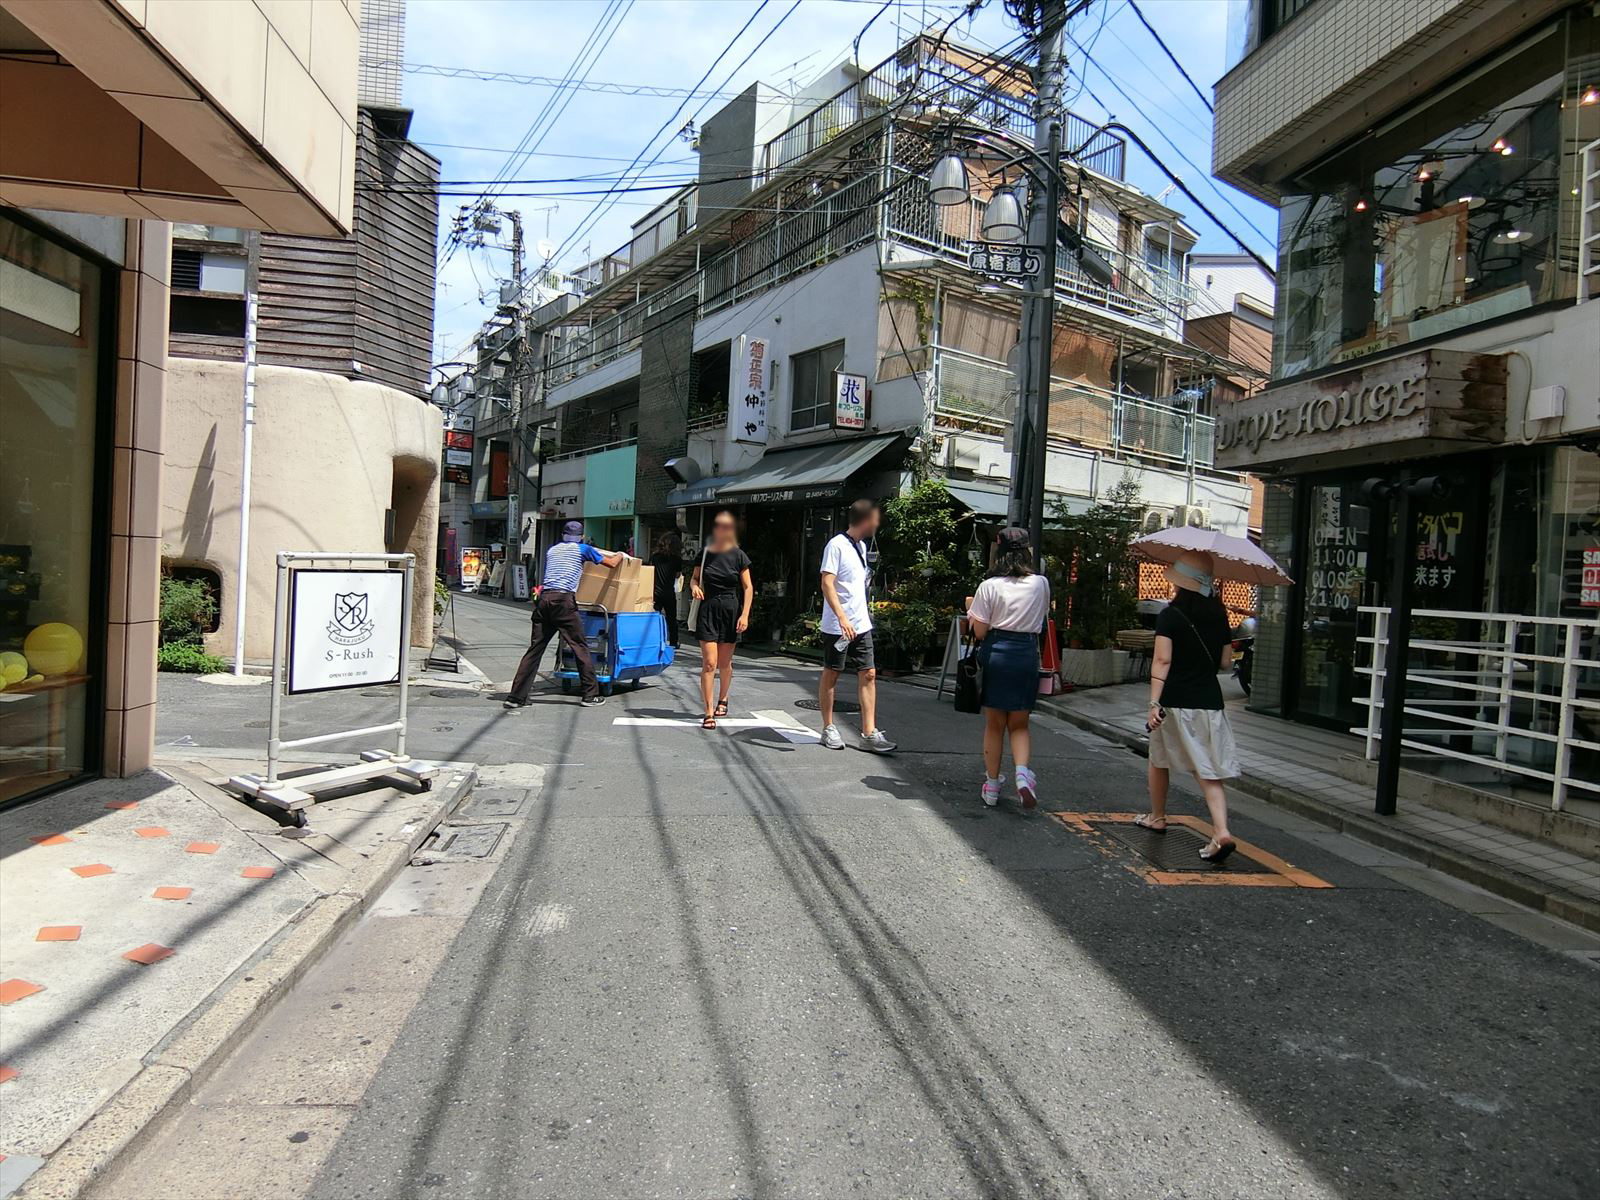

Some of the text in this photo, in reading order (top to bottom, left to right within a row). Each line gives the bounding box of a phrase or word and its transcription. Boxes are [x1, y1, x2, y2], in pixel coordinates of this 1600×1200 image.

[971, 253, 1039, 273] 原宿通り
[749, 340, 765, 390] 菊正宗
[840, 378, 860, 404] 花
[744, 394, 760, 436] 仲や
[1293, 375, 1427, 435] HOUSE
[1314, 527, 1357, 546] OPEN
[1313, 549, 1356, 567] 11:00
[1311, 570, 1355, 589] CLOSE
[1414, 565, 1456, 588] 来ます
[1309, 588, 1350, 609] 21:00
[325, 648, 374, 661] S-Rush
